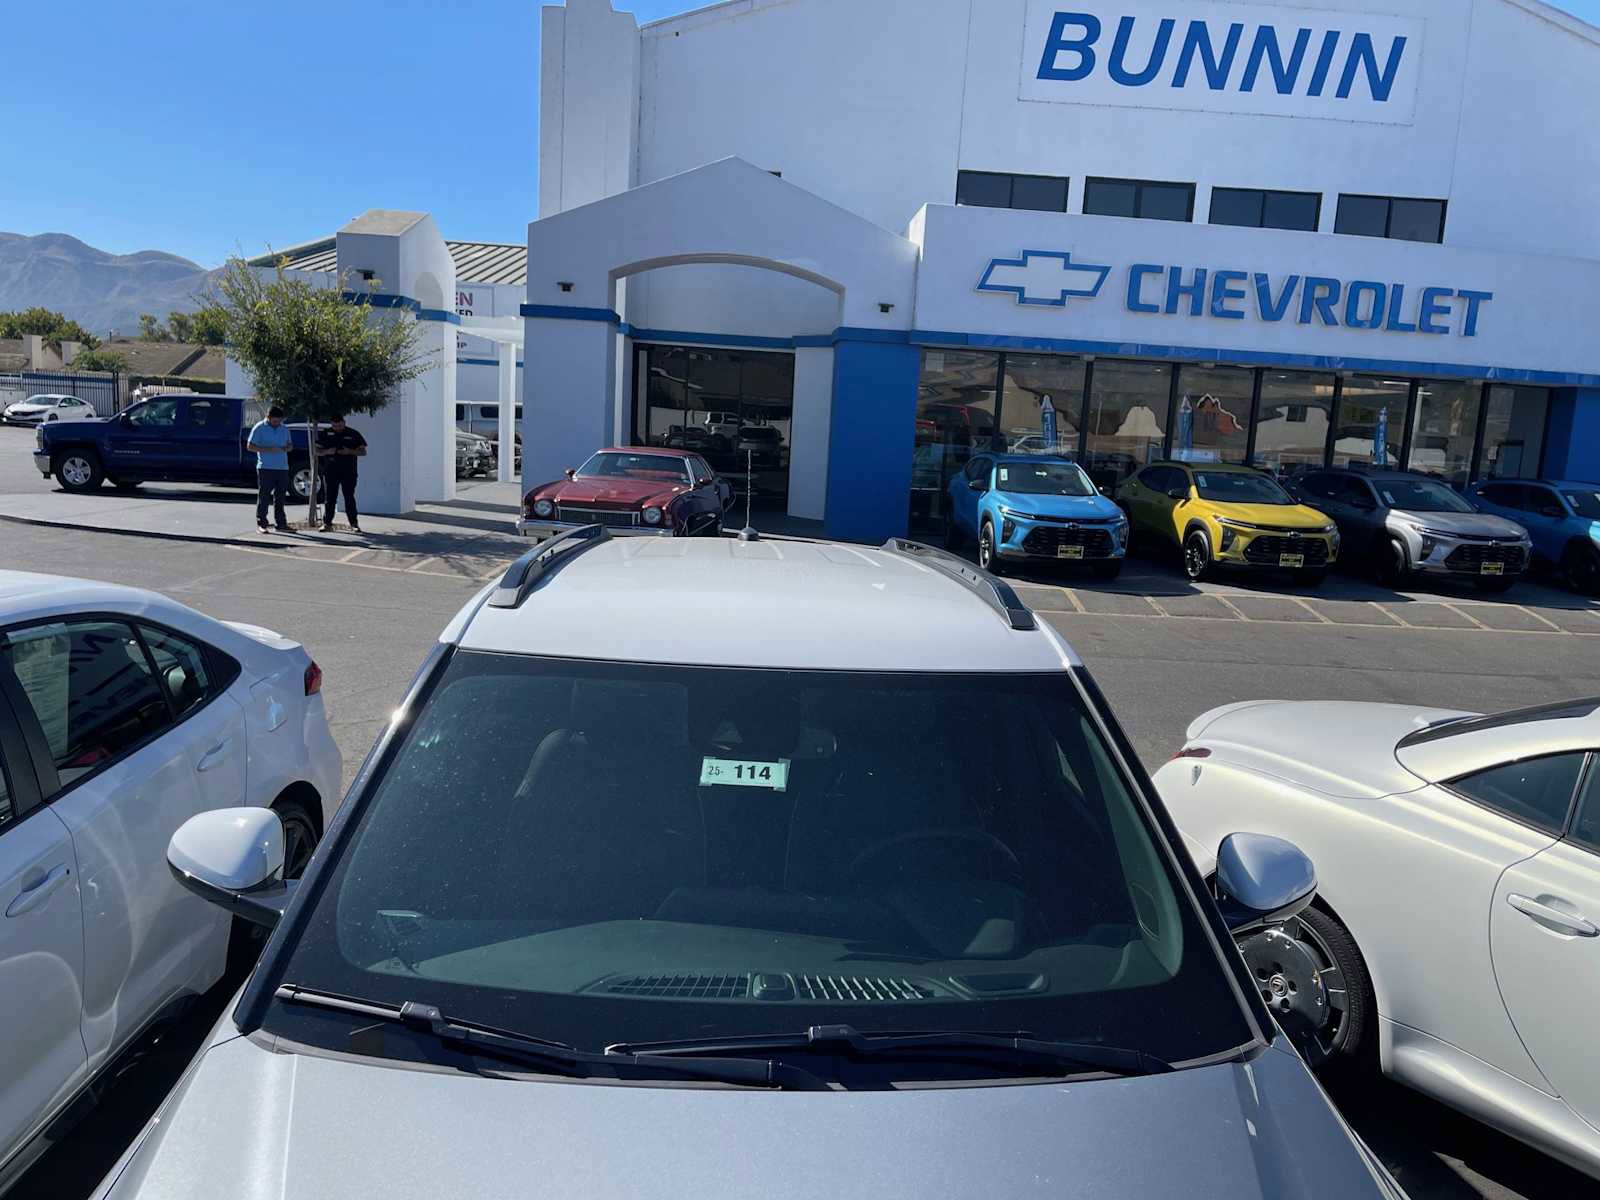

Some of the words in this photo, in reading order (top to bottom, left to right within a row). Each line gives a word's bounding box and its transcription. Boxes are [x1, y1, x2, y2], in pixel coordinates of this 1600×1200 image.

[1037, 12, 1407, 102] BUNNIN
[1126, 264, 1494, 337] CHEVROLET
[734, 764, 771, 780] 114
